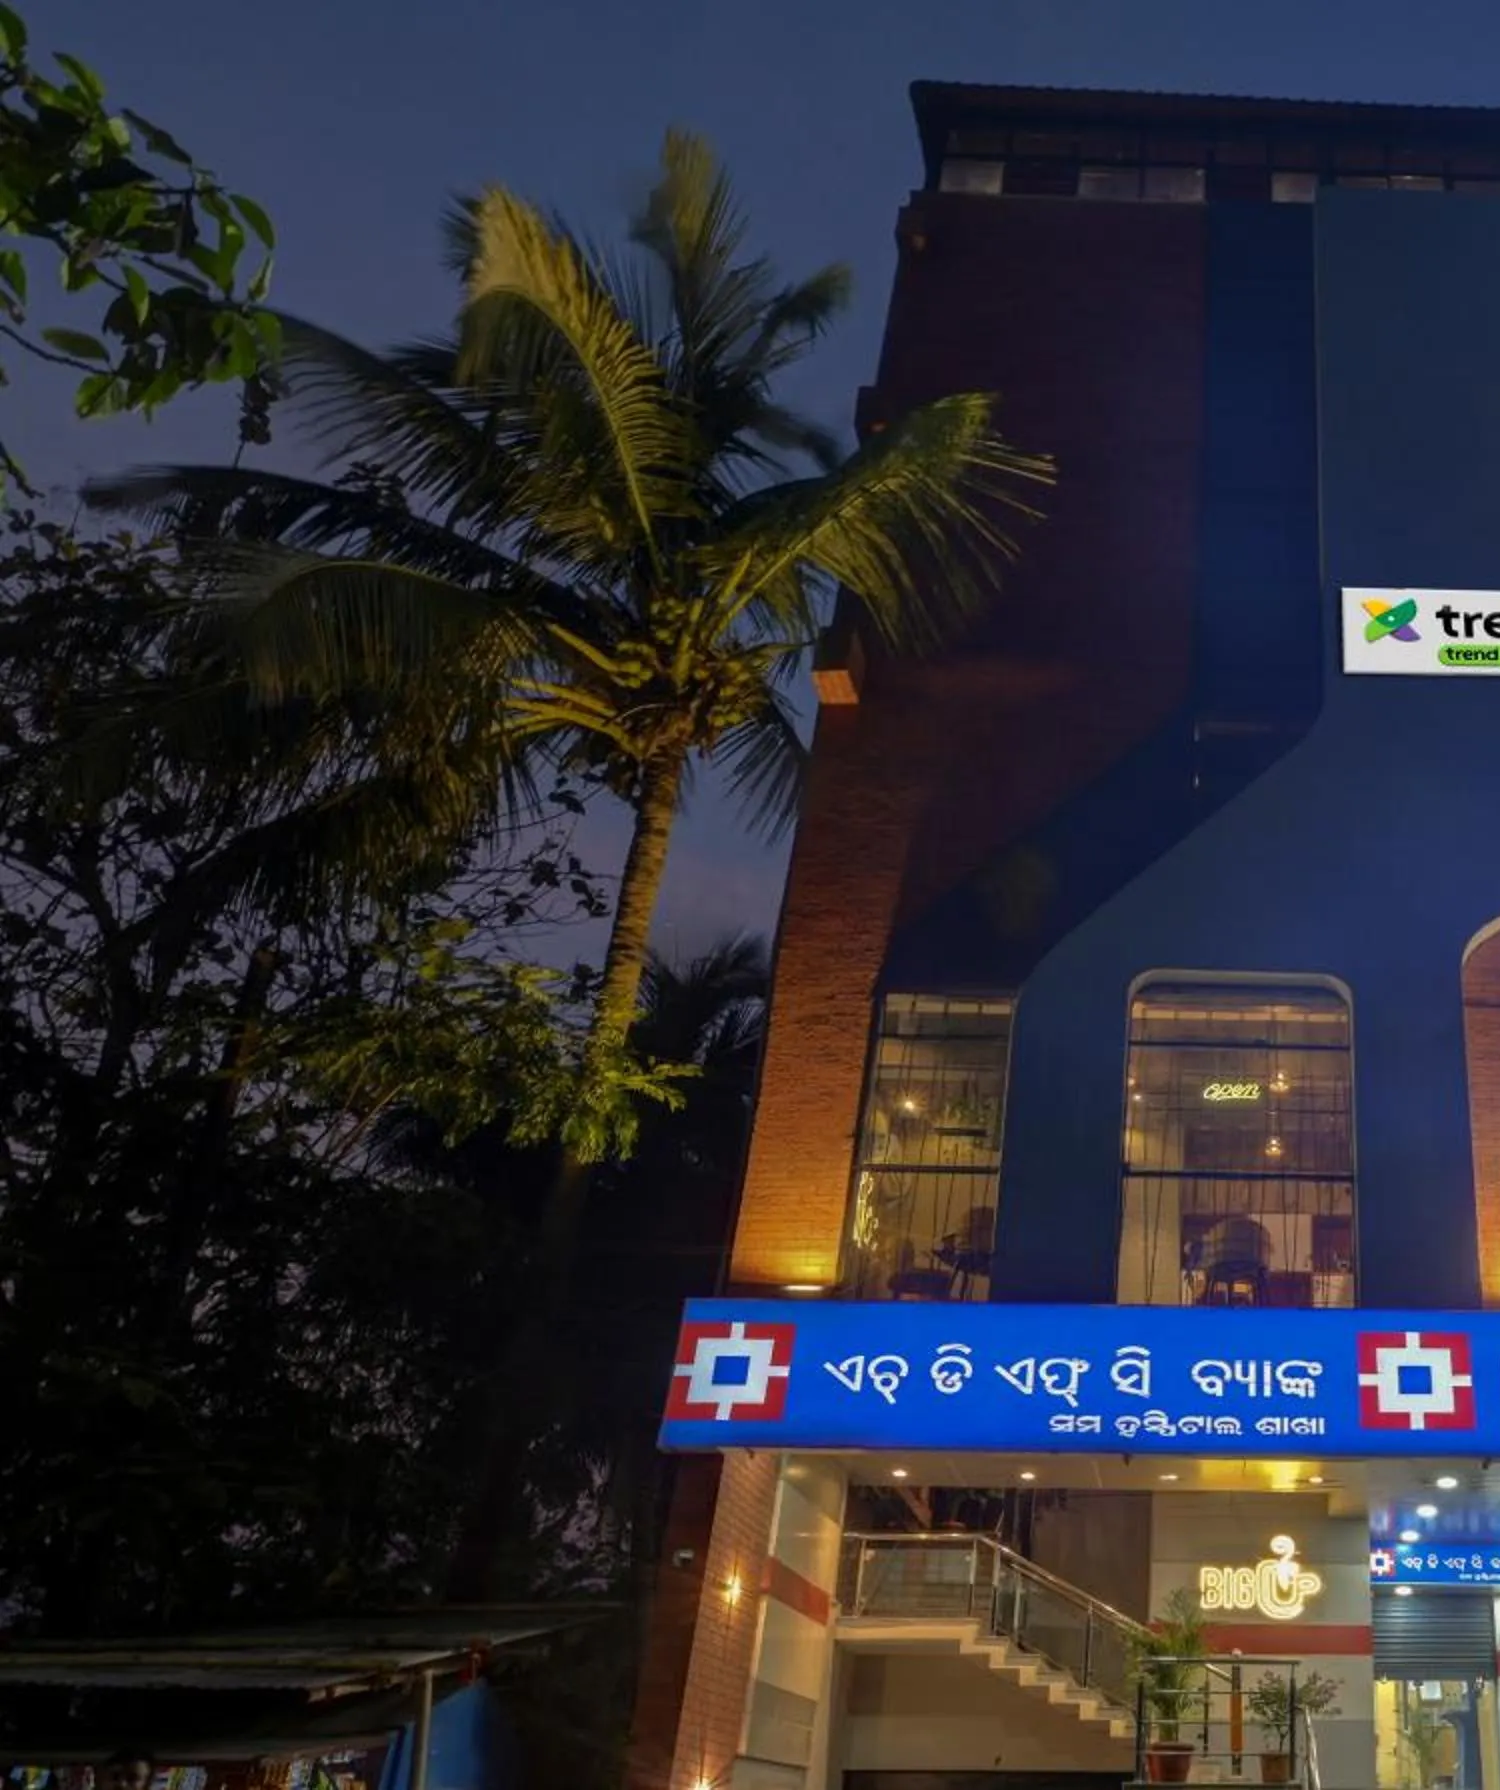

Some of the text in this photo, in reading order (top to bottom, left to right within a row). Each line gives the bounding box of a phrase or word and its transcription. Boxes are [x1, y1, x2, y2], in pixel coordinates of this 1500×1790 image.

[1446, 647, 1500, 662] trend
[823, 1355, 909, 1404] ଏଚ୍
[930, 1343, 973, 1394] ଡି
[1110, 1345, 1152, 1398] ସି
[1191, 1359, 1323, 1398] ବ୍ୟାଙ୍କ
